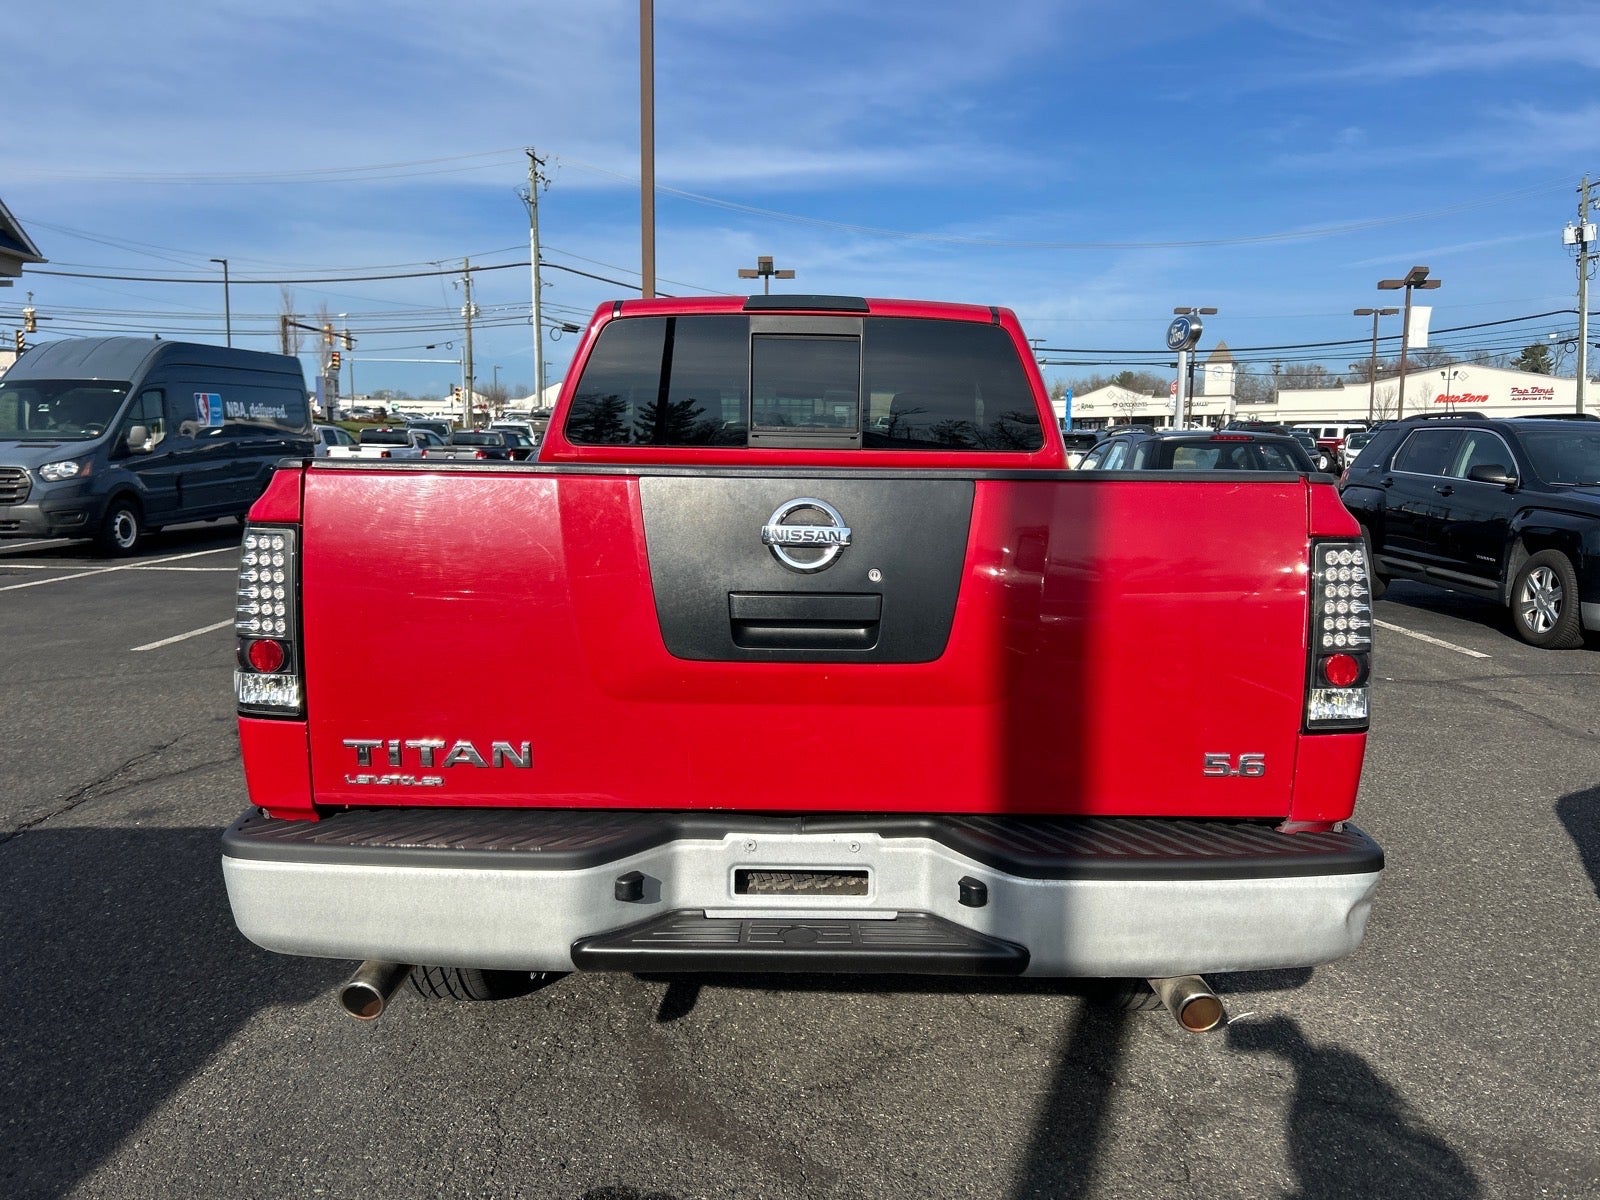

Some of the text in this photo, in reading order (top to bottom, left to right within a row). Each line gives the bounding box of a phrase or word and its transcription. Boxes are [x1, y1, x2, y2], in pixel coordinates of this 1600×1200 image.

[1169, 322, 1187, 344] Ford
[1434, 393, 1489, 403] AutoZone
[1530, 386, 1555, 395] Boys
[226, 401, 249, 419] NBA,
[771, 528, 841, 542] NISSAN
[343, 738, 533, 768] TITAN
[1203, 752, 1265, 777] 5.6
